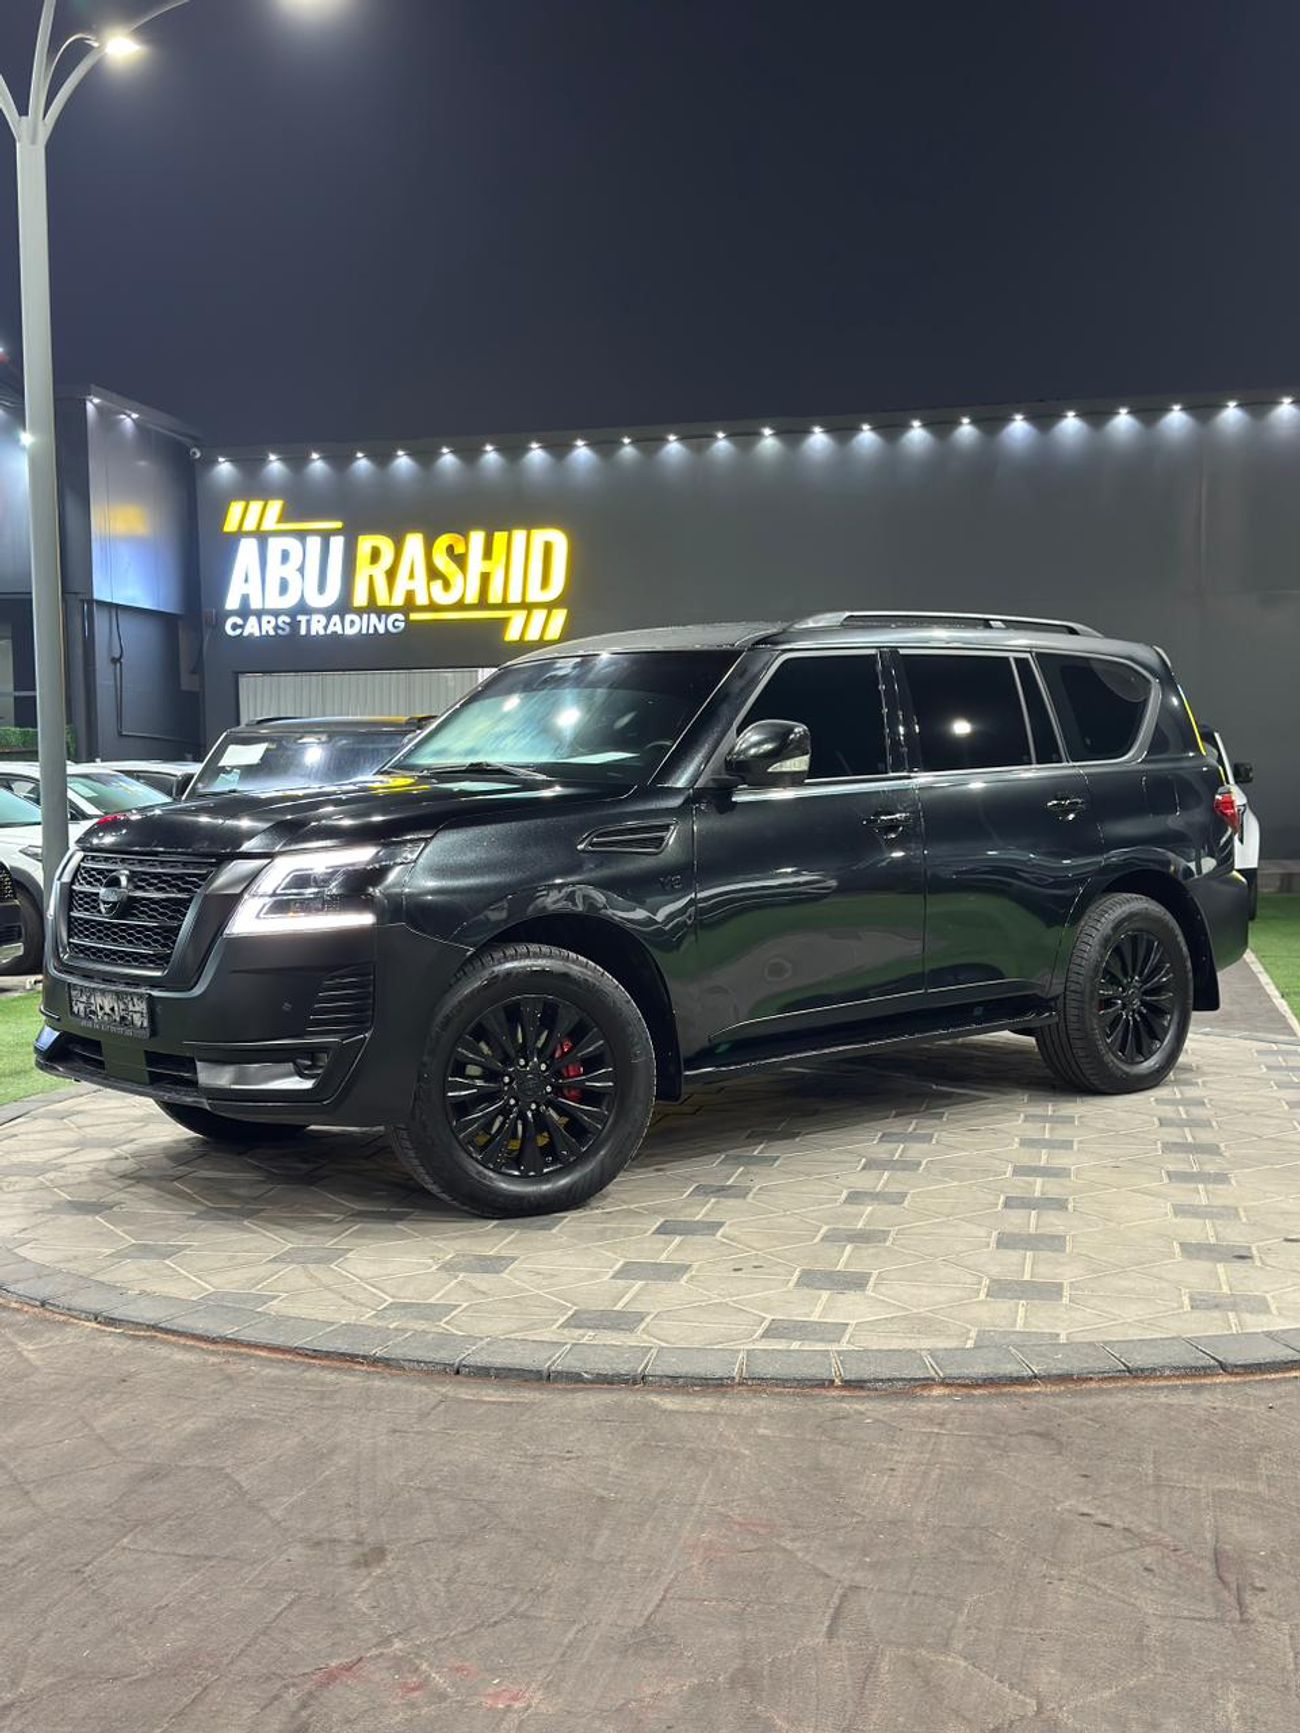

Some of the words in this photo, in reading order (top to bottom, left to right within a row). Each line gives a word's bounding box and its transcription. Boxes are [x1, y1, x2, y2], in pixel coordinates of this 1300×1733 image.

[224, 535, 345, 610] ABU
[352, 528, 568, 607] RASHID
[224, 616, 291, 637] CARS
[297, 613, 405, 636] TRADING
